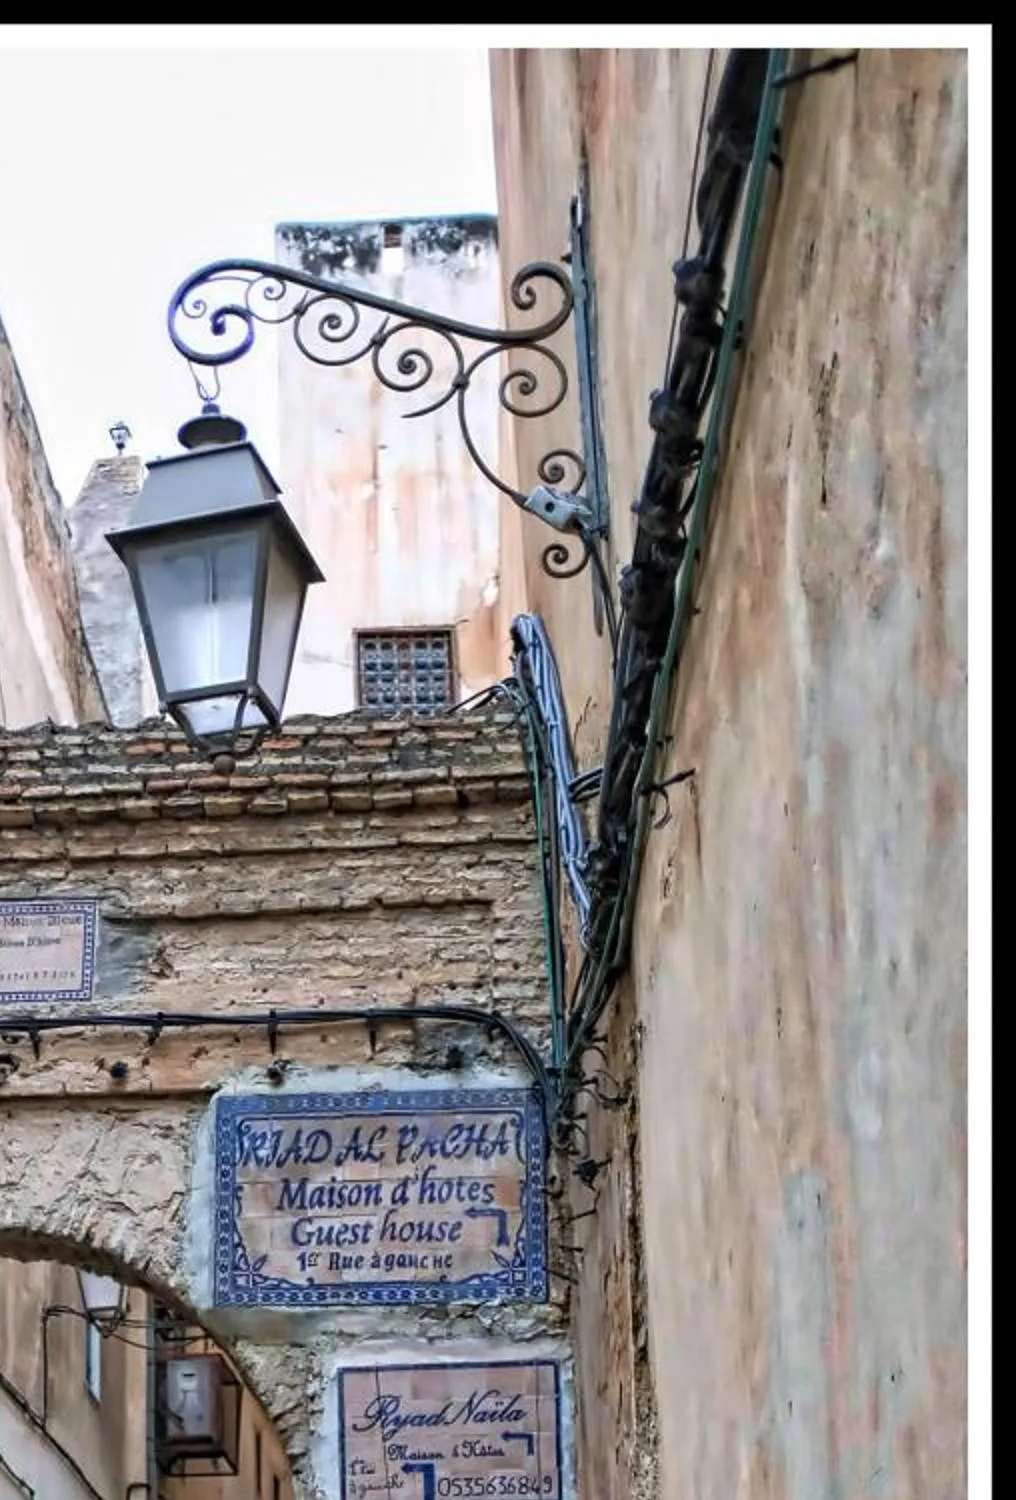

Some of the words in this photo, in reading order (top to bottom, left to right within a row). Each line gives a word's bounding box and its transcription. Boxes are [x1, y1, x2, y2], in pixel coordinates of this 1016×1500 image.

[242, 1129, 333, 1168] RIAD
[335, 1125, 388, 1166] AL
[396, 1121, 509, 1165] PACHA
[276, 1176, 383, 1211] Maison
[291, 1216, 373, 1247] Guest
[380, 1208, 463, 1243] house
[329, 1251, 365, 1270] Rue
[352, 1394, 451, 1441] Ryad
[447, 1388, 527, 1426] Naïla
